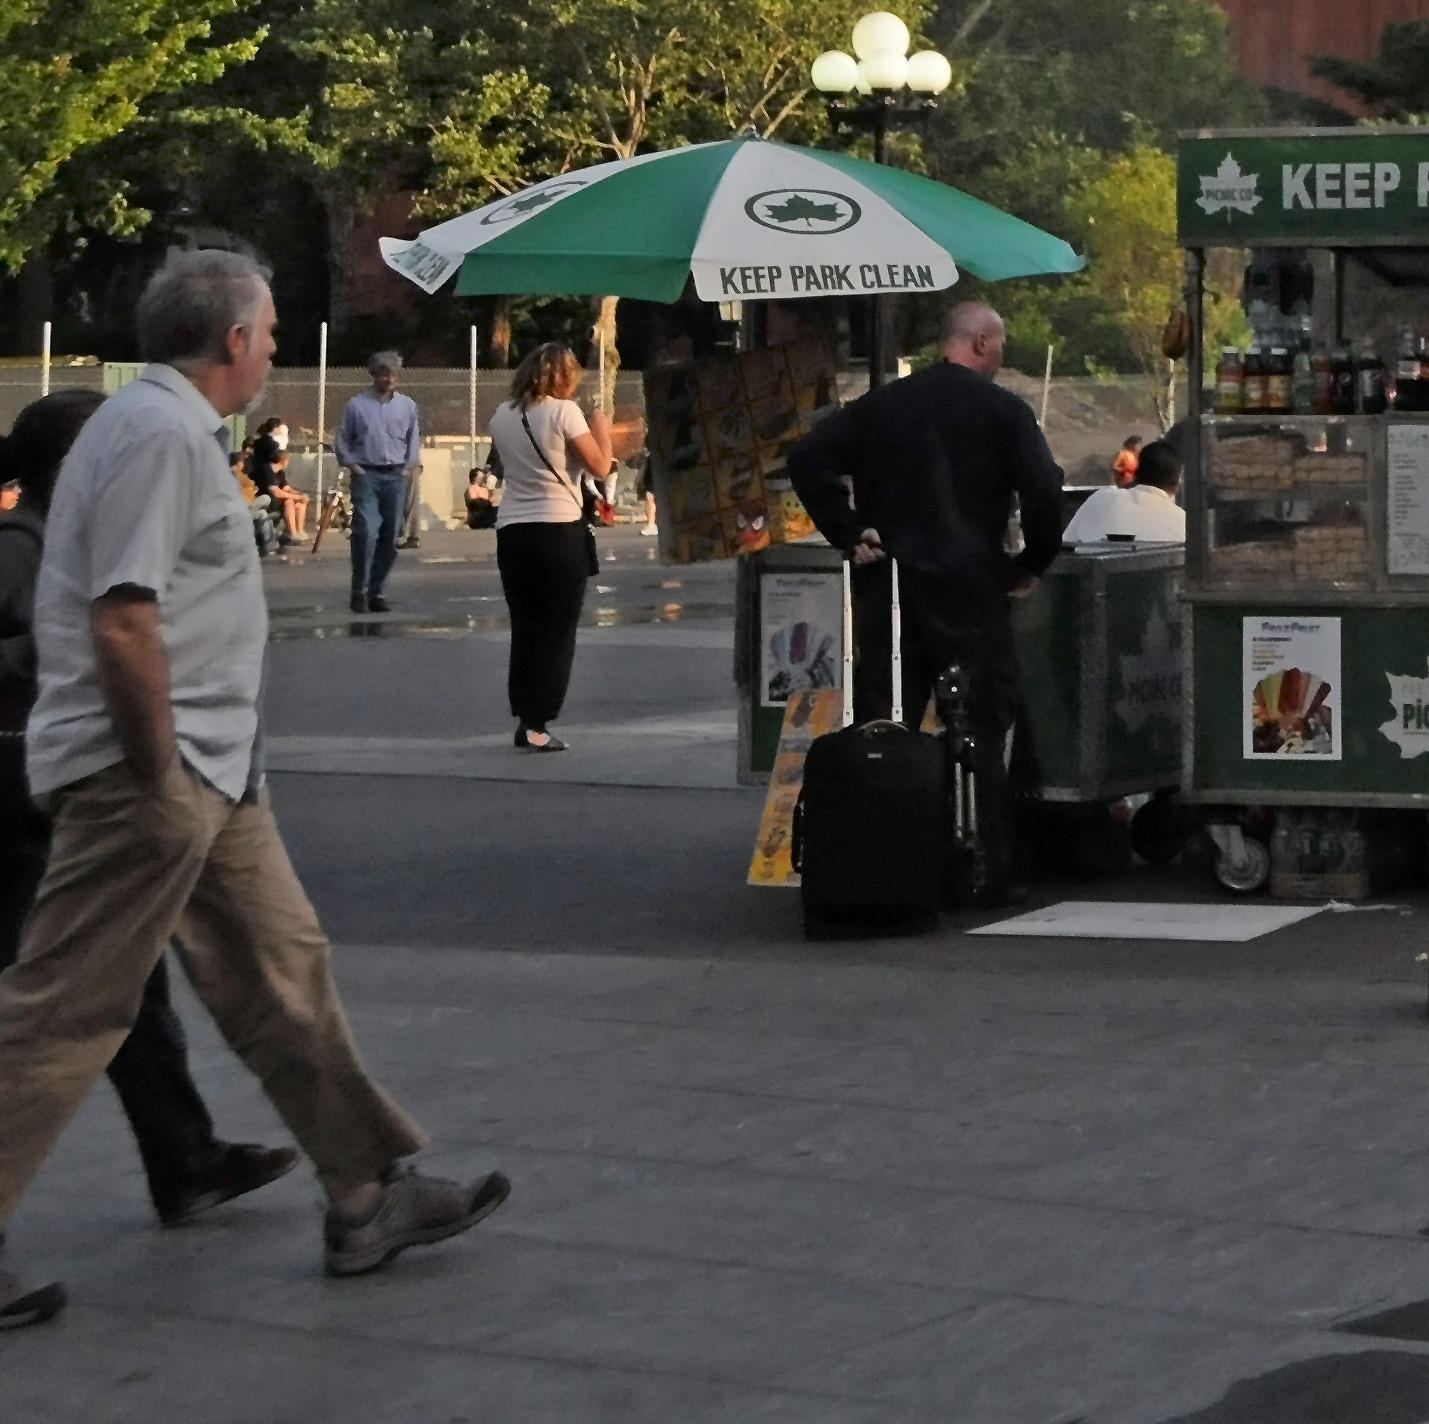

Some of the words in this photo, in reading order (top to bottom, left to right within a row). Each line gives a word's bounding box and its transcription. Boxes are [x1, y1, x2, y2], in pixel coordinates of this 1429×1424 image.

[1282, 162, 1401, 209] KEEP
[719, 265, 782, 295] KEEP
[789, 264, 855, 292] PARK
[859, 263, 936, 289] CLEAN
